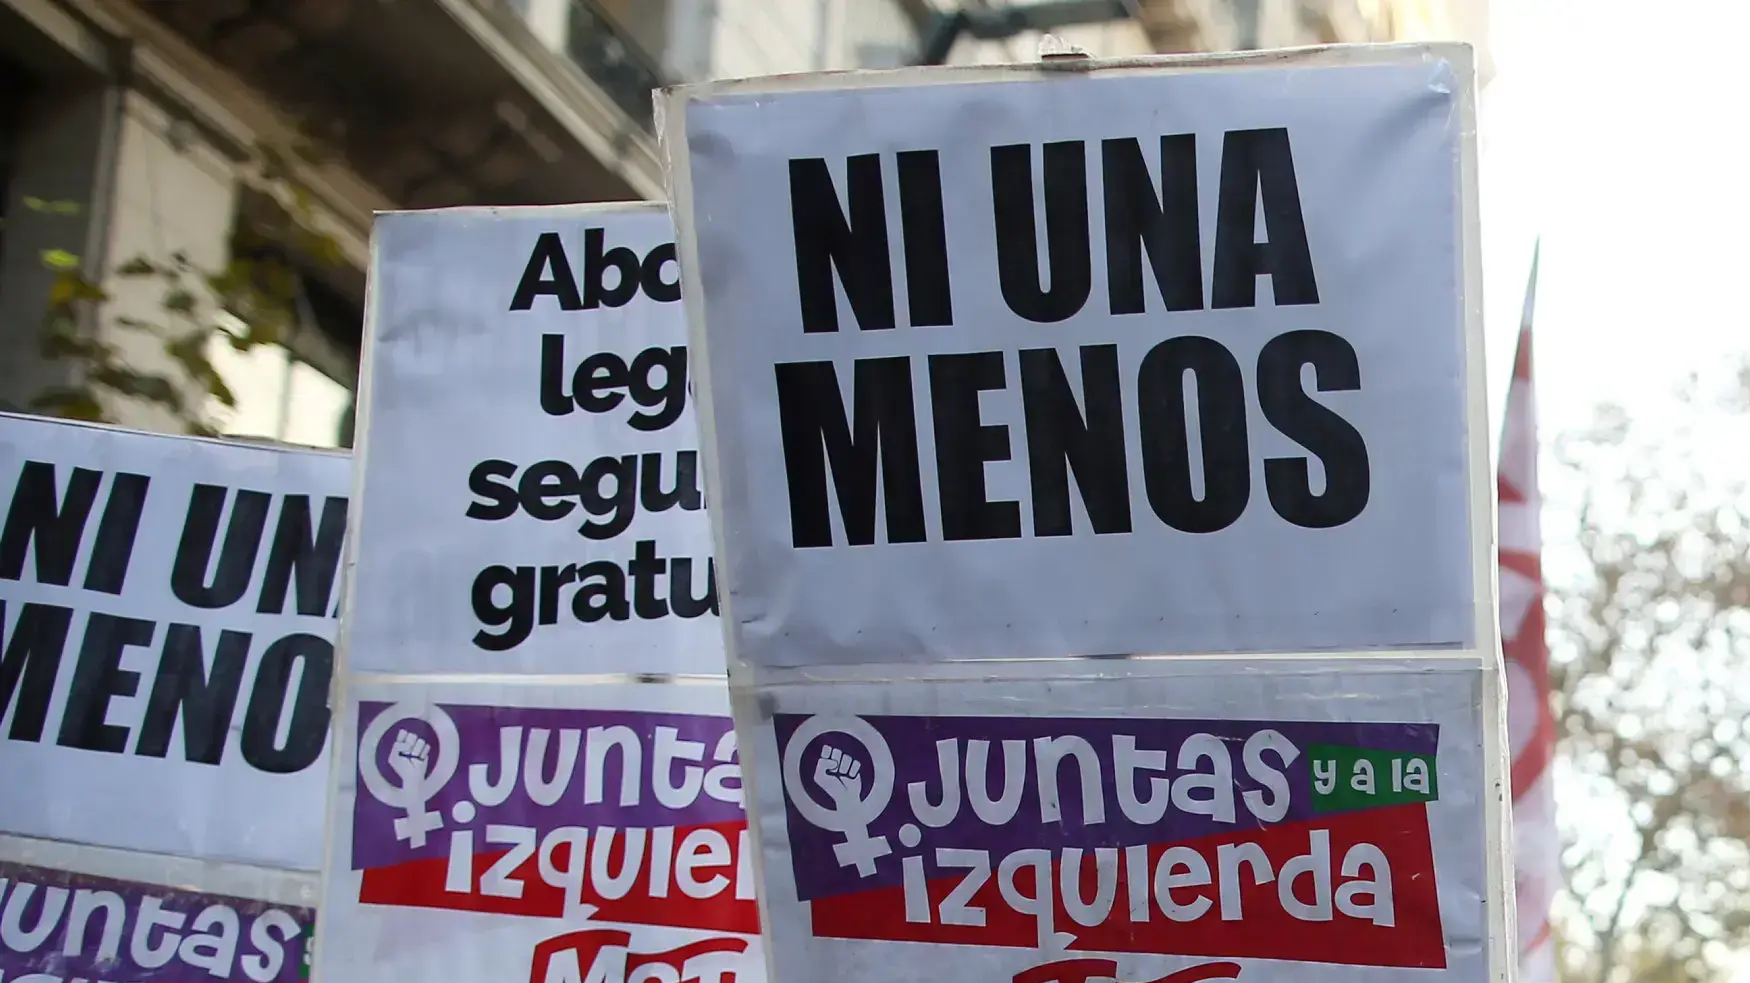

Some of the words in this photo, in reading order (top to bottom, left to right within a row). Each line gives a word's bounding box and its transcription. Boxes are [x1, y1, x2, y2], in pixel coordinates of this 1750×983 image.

[509, 228, 681, 311] Abo
[788, 149, 954, 334] NI
[990, 127, 1320, 323] UNA
[539, 333, 692, 431] leg
[466, 449, 706, 539] segu
[775, 329, 1370, 549] MENOS
[0, 460, 151, 595] NI
[171, 483, 349, 618] UN
[472, 540, 720, 651] gratu
[0, 601, 334, 774] MENO
[469, 724, 745, 808] junta
[1313, 759, 1337, 797] y
[1349, 758, 1375, 796] a
[1392, 756, 1431, 795] la
[446, 800, 756, 920] izquie
[898, 825, 1396, 950] izquierda
[0, 878, 300, 983] untas
